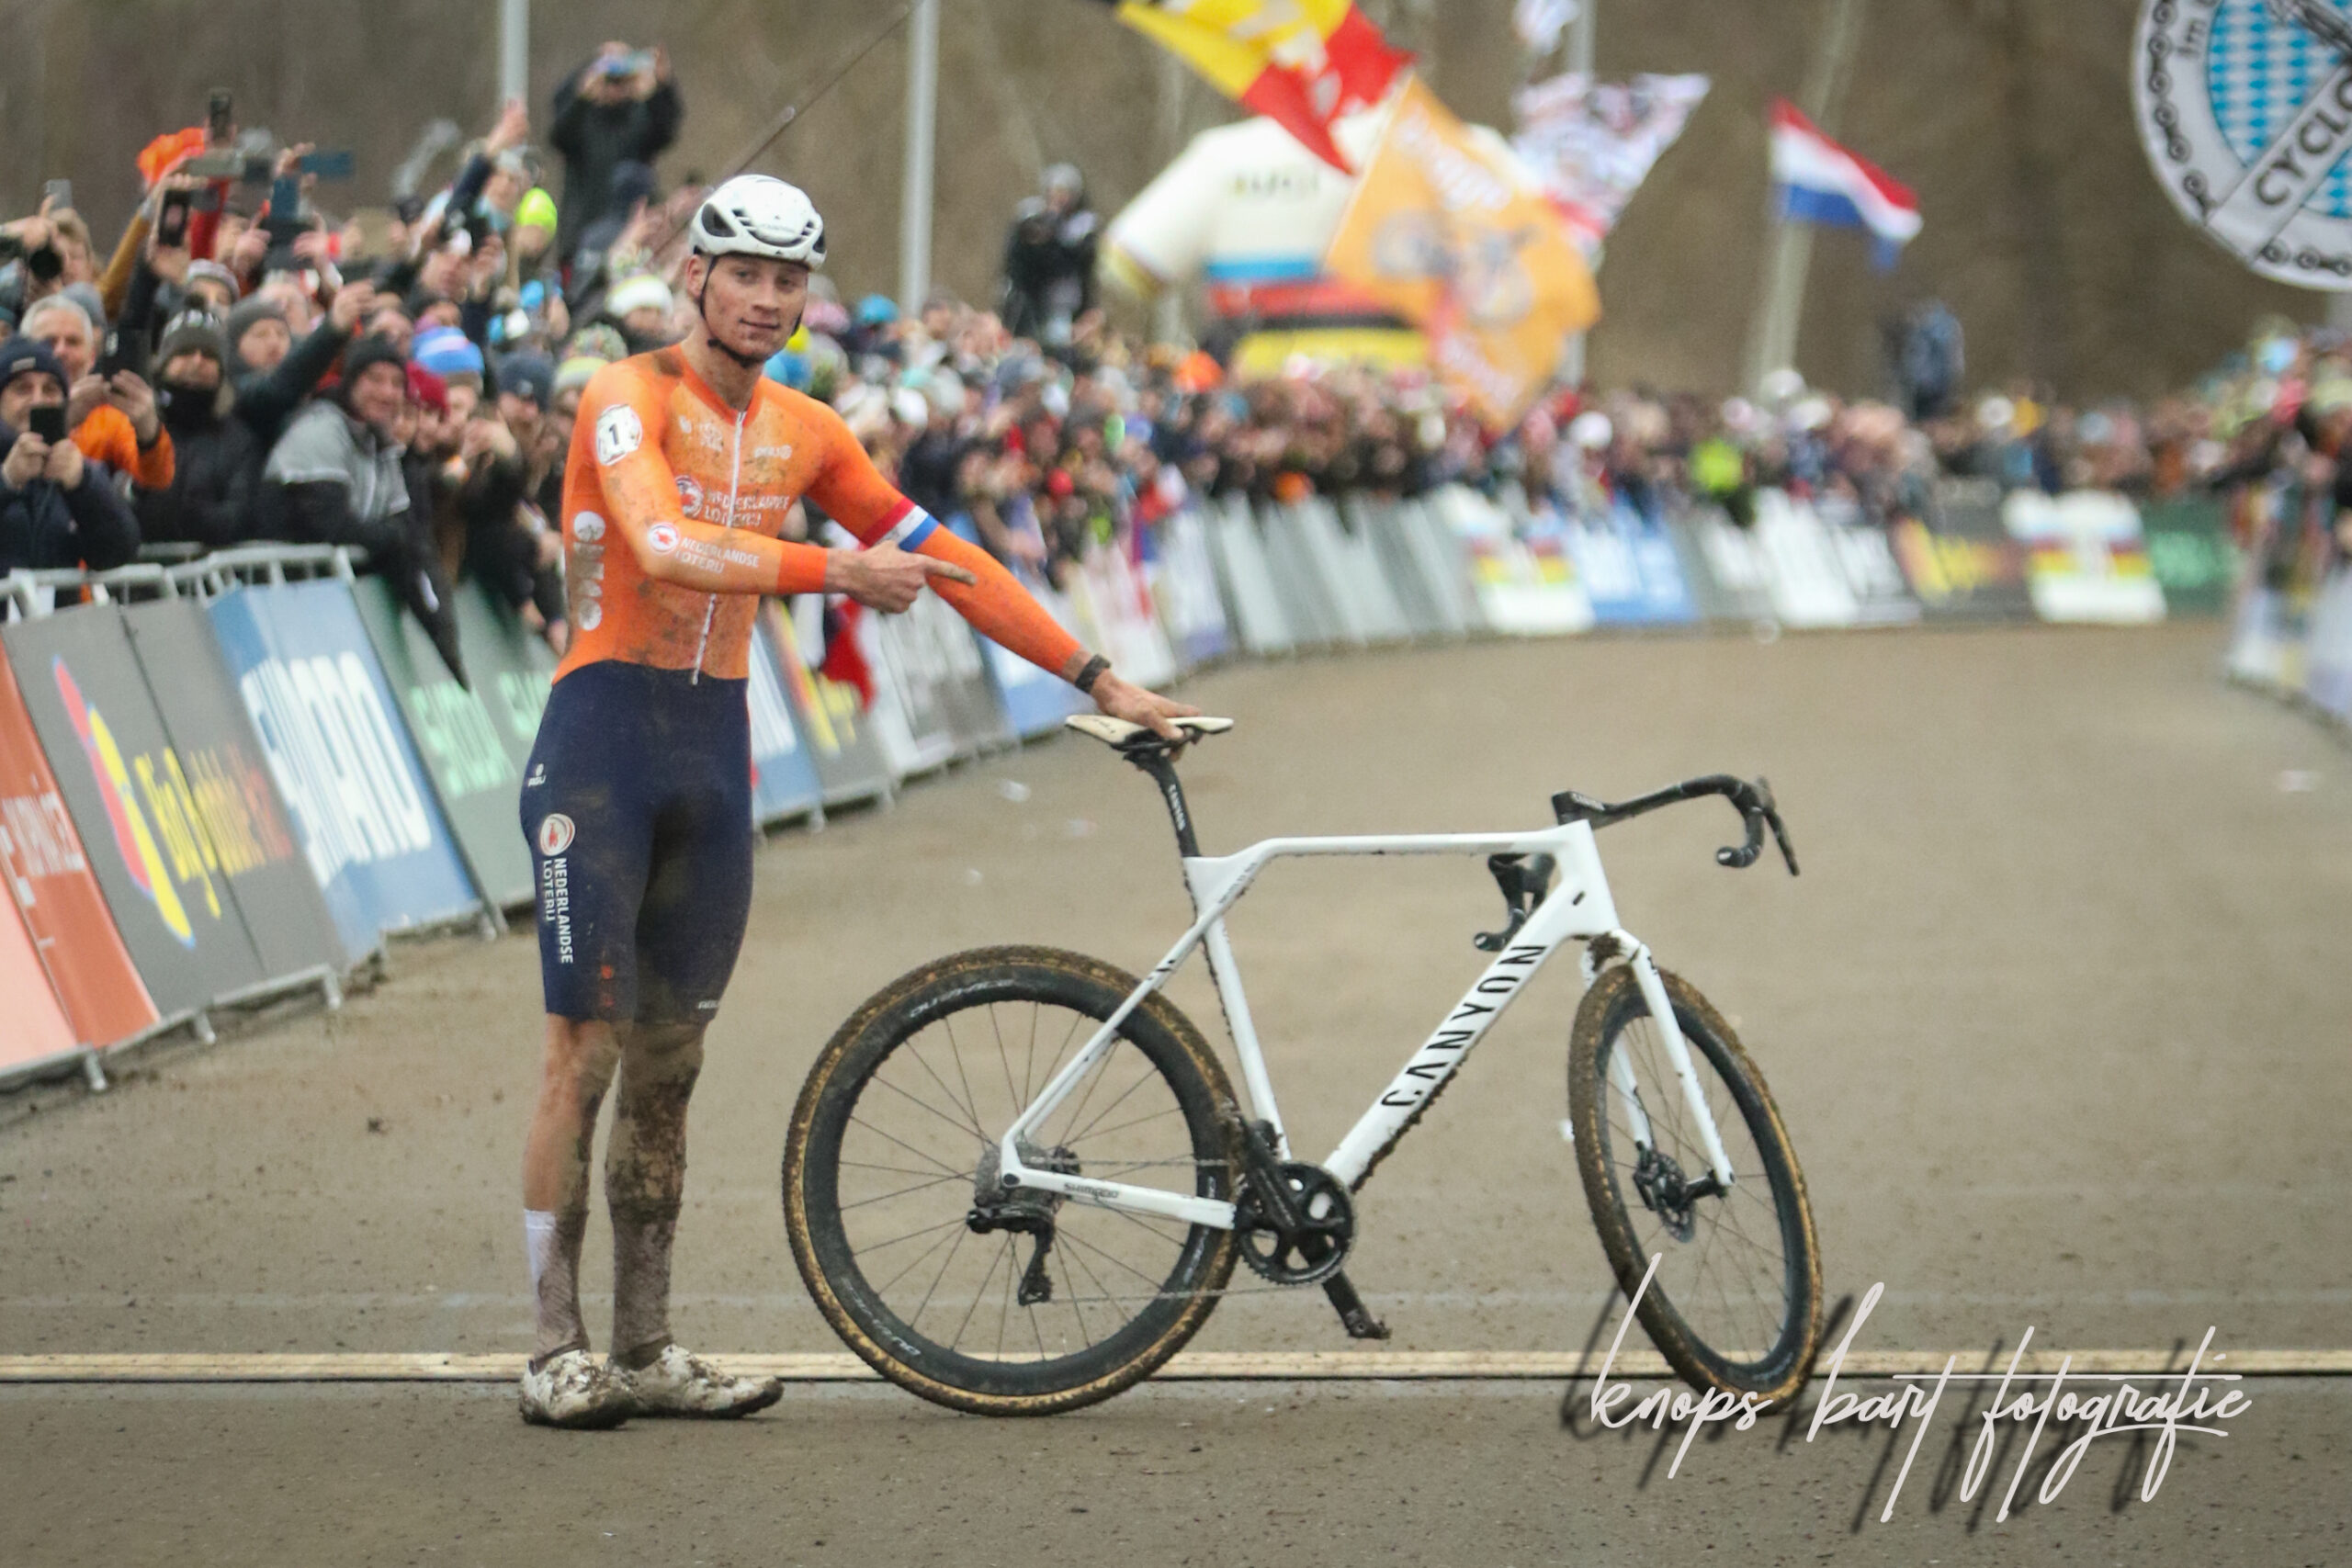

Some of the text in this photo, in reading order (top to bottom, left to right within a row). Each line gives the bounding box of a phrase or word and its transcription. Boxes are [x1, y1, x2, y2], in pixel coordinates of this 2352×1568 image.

[608, 423, 620, 446] 1
[680, 536, 760, 568] NEDERLANDSE
[543, 860, 556, 921] LOTERIJ
[554, 857, 573, 964] NEDERLANDSE
[1381, 945, 1548, 1107] CANYON
